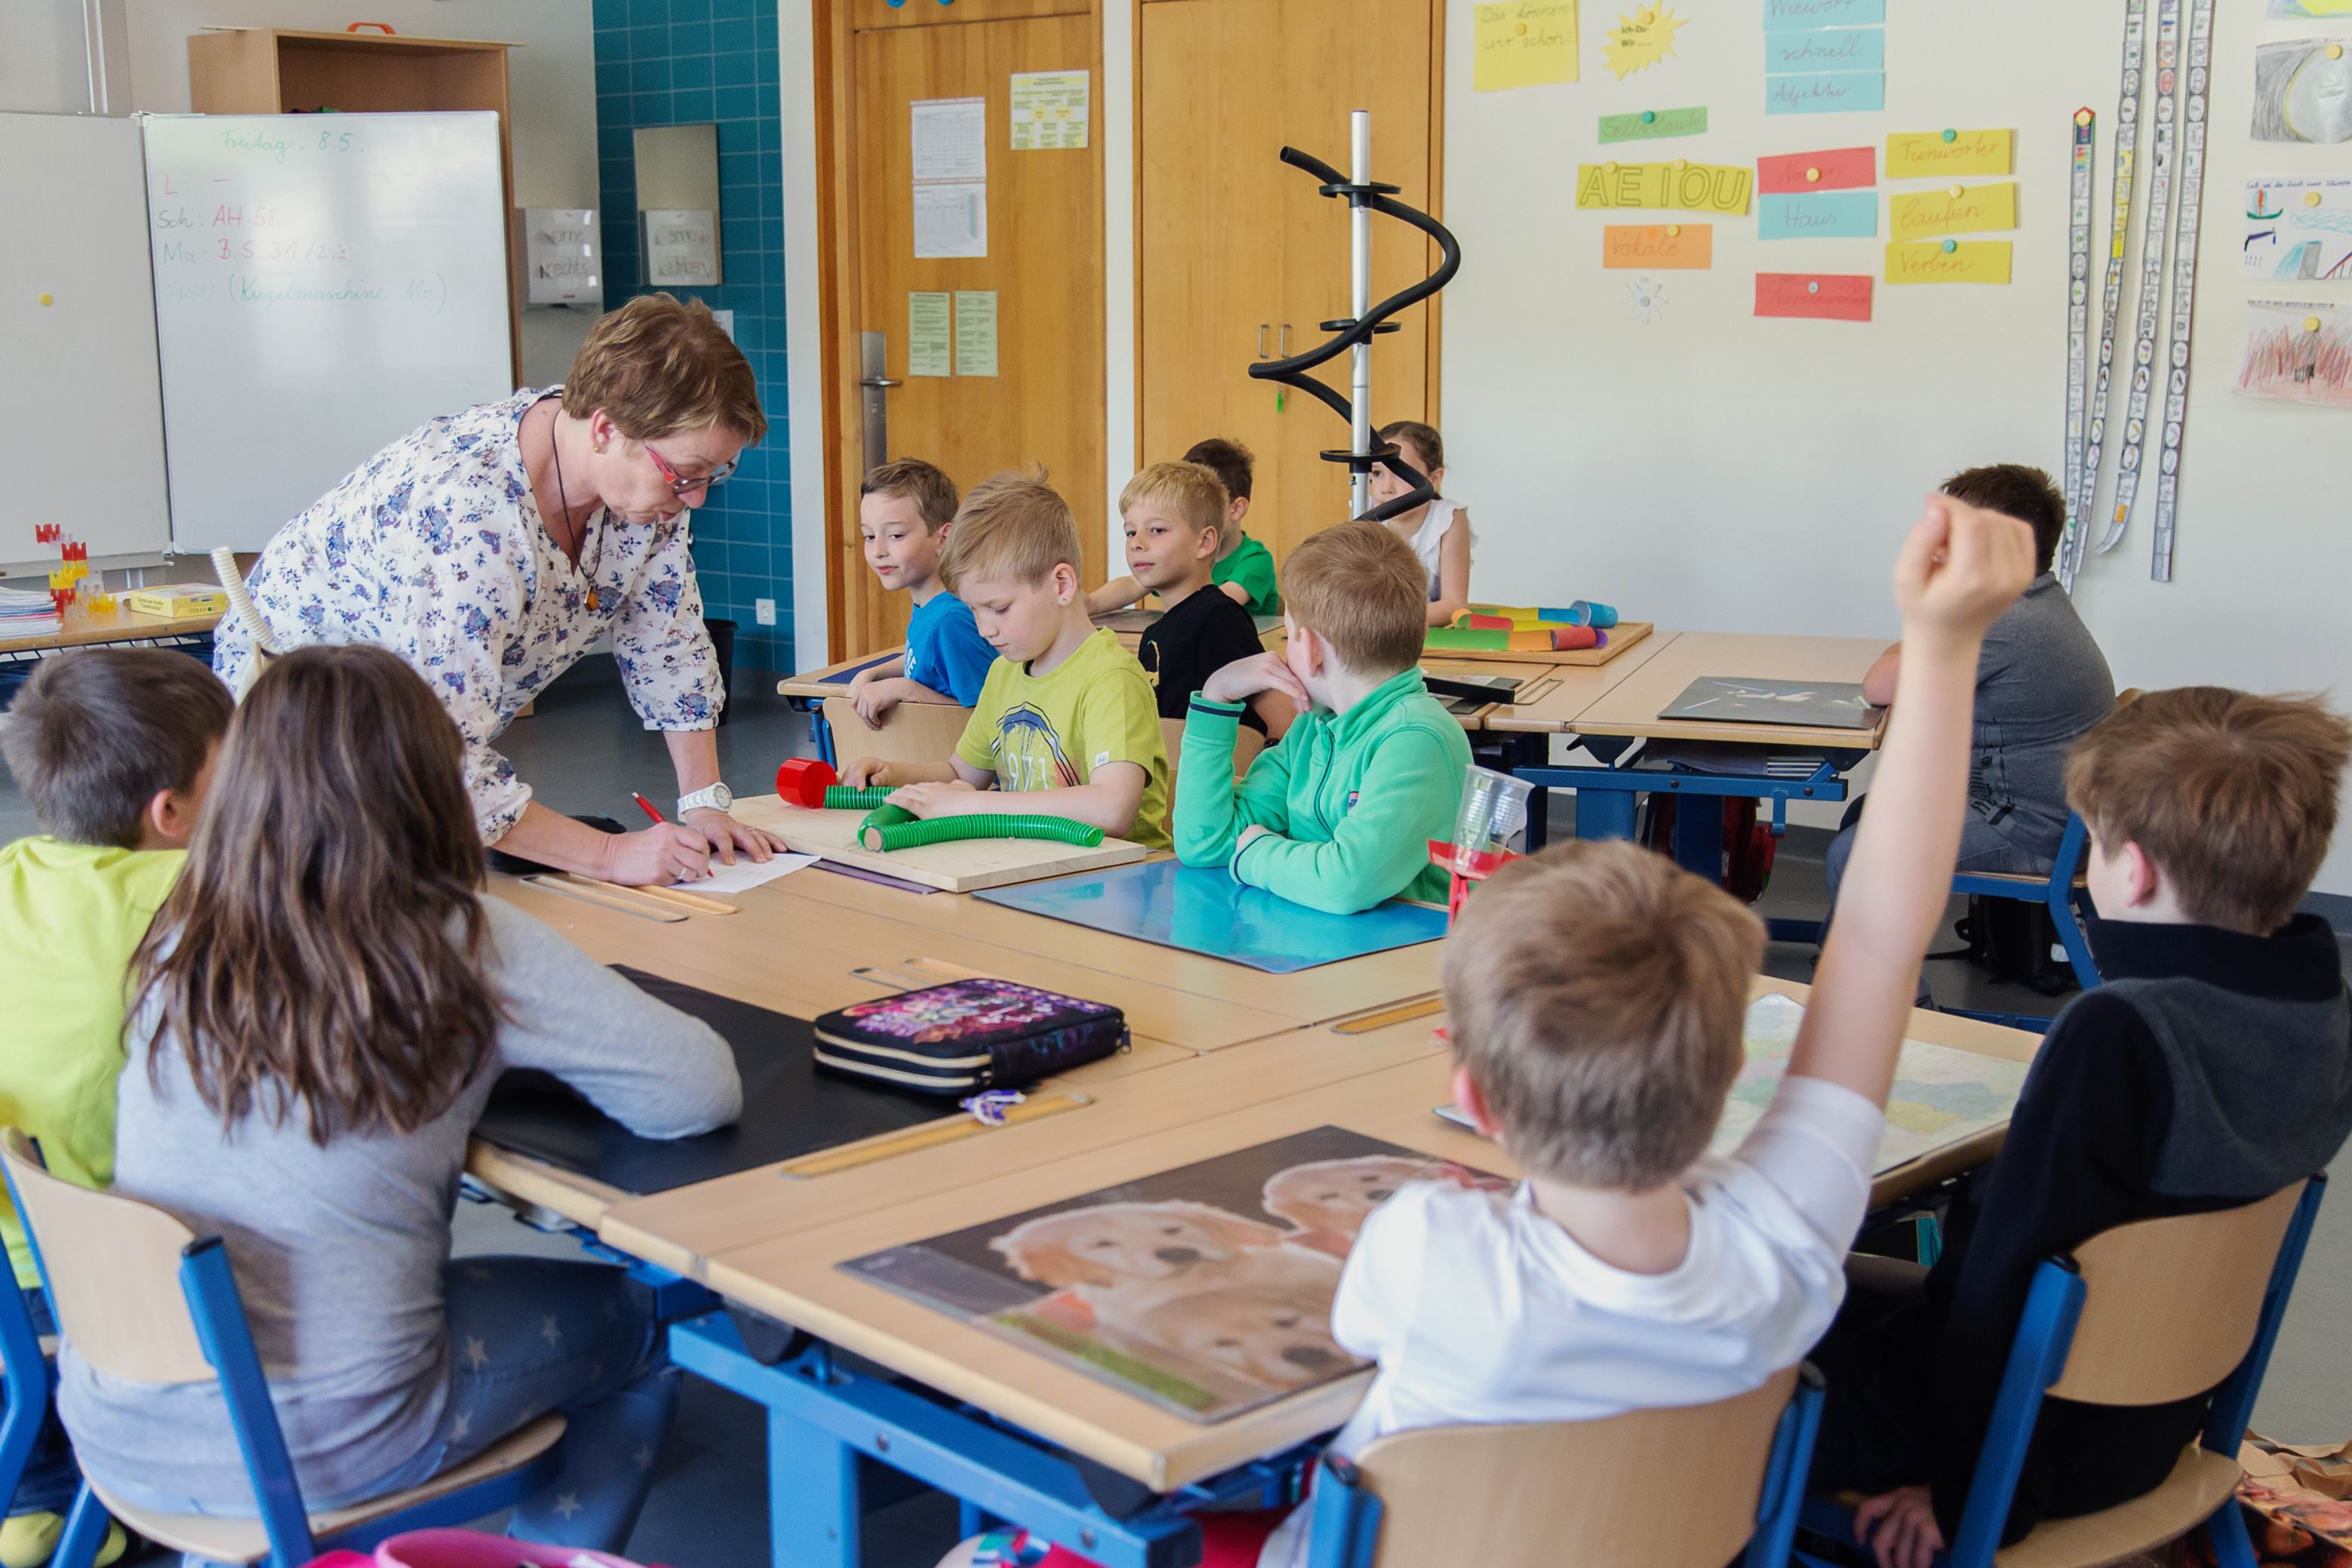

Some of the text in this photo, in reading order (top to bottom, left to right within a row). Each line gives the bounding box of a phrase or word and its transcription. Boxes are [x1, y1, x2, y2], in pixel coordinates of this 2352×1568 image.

[1779, 34, 1867, 61] schnell
[1776, 159, 1849, 186] Noen
[212, 204, 244, 227] AH
[1783, 201, 1838, 229] Haus
[1900, 197, 1988, 230] laufen
[552, 229, 584, 244] orne
[1611, 231, 1681, 258] Vokale
[1901, 247, 1982, 274] Verben
